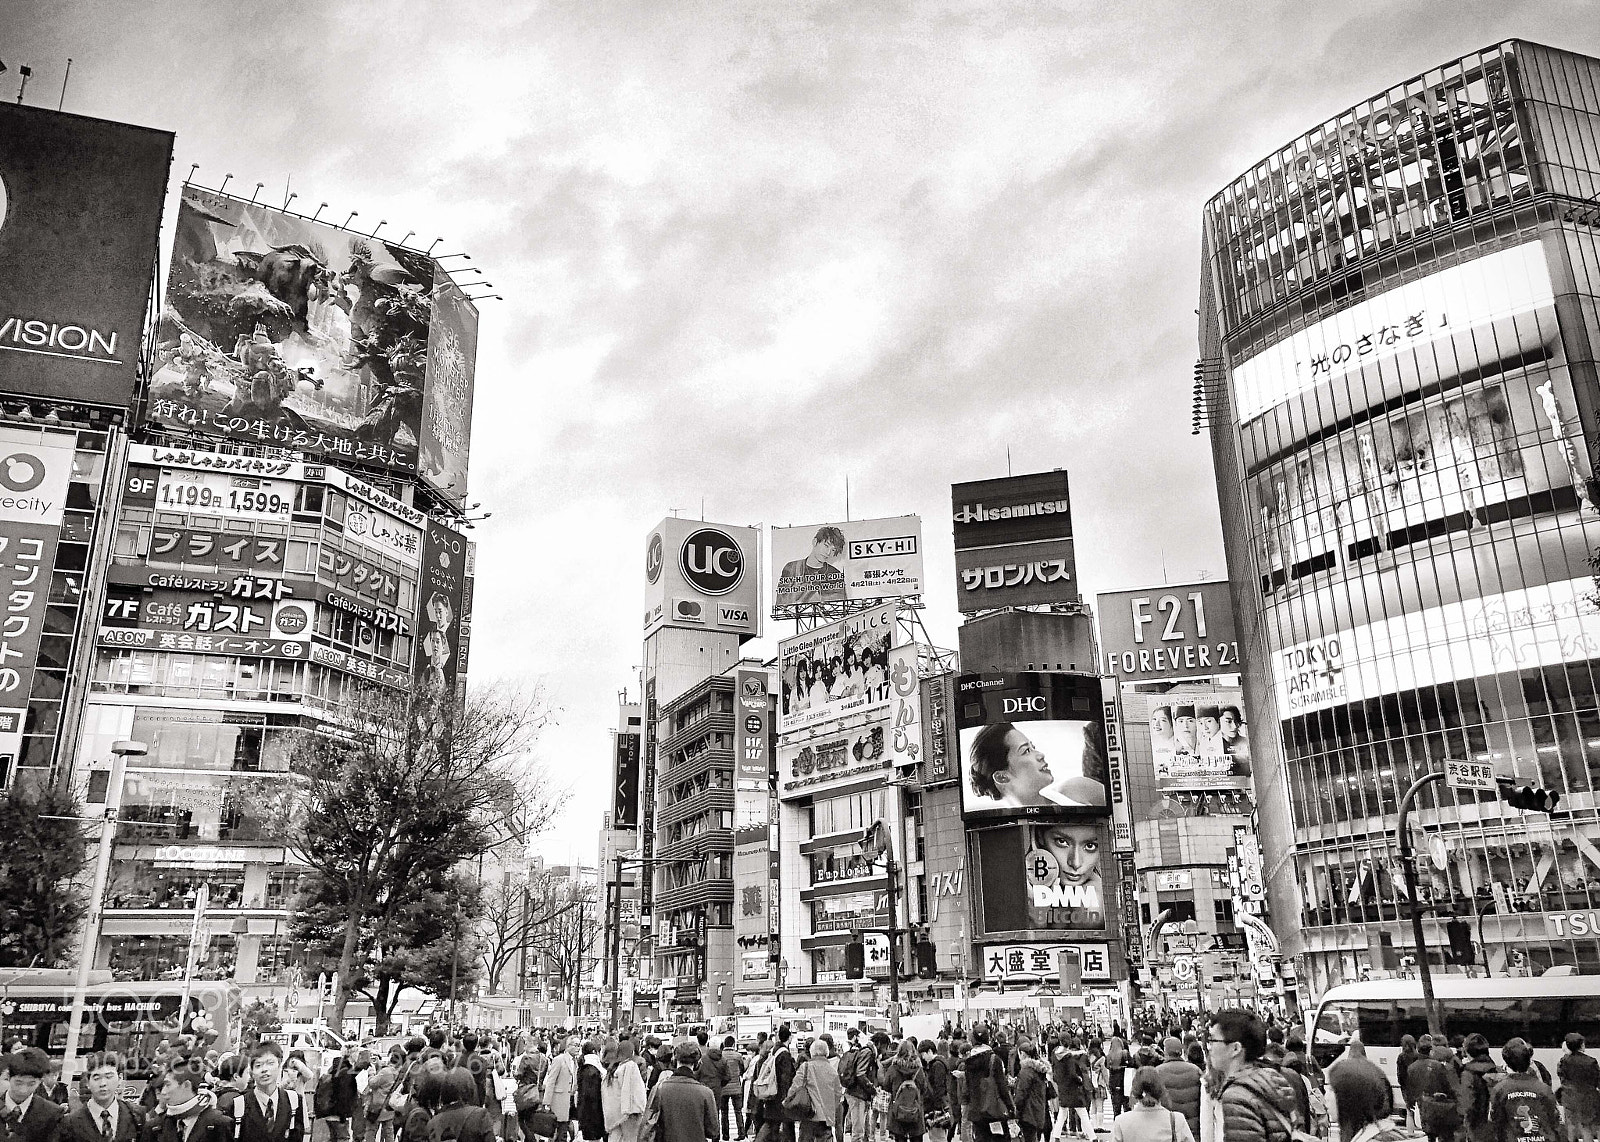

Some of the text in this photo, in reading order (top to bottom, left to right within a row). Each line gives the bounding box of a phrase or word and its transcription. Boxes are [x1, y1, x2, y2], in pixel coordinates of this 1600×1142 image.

[152, 449, 291, 475] しゃぶしゃぶバイキング
[129, 477, 155, 494] 9F
[161, 483, 222, 507] 1,199円
[0, 496, 52, 515] ecity
[229, 490, 290, 514] 1,599円
[345, 476, 425, 524] しゃぶしゃぶバイキング
[953, 500, 1068, 523] Hisamitsu
[154, 532, 282, 563] プライス
[431, 530, 460, 554] EXO
[855, 540, 912, 556] SKY-HI
[687, 543, 738, 578] UC
[320, 549, 396, 596] コンタクト
[806, 574, 825, 582] TOUR
[961, 559, 1070, 591] サロンパス
[231, 576, 293, 600] ガスト
[0, 538, 44, 692] コンタクトの
[107, 600, 139, 618] 7F
[145, 616, 180, 625] レストラン
[146, 602, 182, 616] Café
[183, 602, 265, 633] ガスト
[721, 608, 749, 621] VISA
[1131, 592, 1207, 643] F21
[280, 617, 304, 627] ガスト
[374, 608, 409, 634] ガスト
[104, 631, 146, 645] AEON
[283, 644, 301, 655] 6F
[783, 632, 839, 656] Little Glee Monster
[316, 648, 342, 665] AEON
[1107, 641, 1240, 674] FOREVER 21
[1284, 640, 1340, 670] TOKYO
[960, 678, 1004, 691] DHC Channel
[891, 657, 920, 760] もんじゃ
[1002, 696, 1046, 714] DHC
[1291, 684, 1346, 710] SCRAMBLE
[1104, 694, 1123, 803] Taisei neon
[1448, 762, 1492, 779] 渋谷駅前
[1456, 777, 1478, 786] Shibuya
[817, 863, 870, 881] Euphoria
[988, 949, 1103, 972] 大盛堂店
[19, 1003, 56, 1012] SHIBUYA
[106, 1003, 122, 1011] bus
[124, 1002, 161, 1011] HACHIKO
